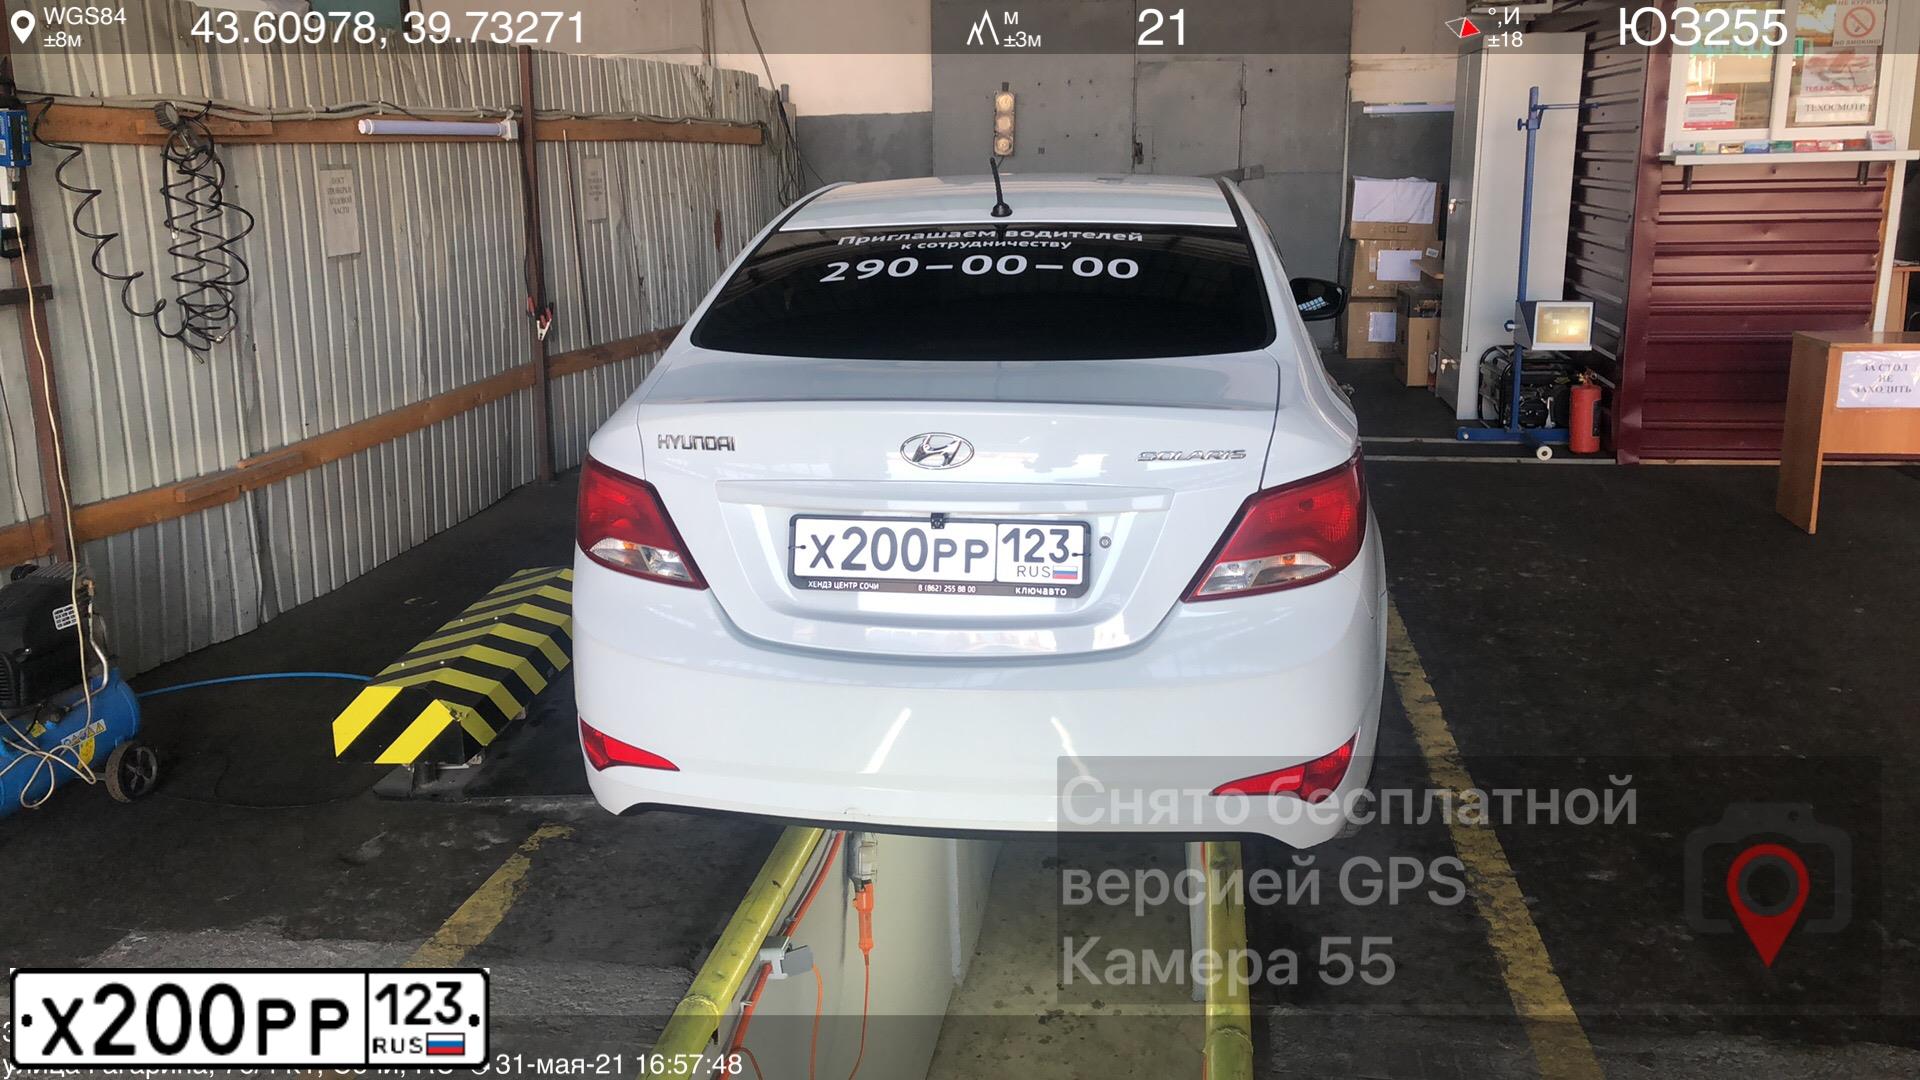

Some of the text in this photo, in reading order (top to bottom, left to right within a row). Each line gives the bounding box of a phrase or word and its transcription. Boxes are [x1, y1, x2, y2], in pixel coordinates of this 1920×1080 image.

[1805, 103, 1866, 113] ТЕХОСМОТР
[837, 230, 1143, 246] Приглашаем водителей
[917, 240, 1072, 250] сотрудничеству
[657, 434, 736, 452] HYUNDAI
[1137, 449, 1247, 462] SOLARIS
[808, 525, 1070, 574] Х200РР 123
[1015, 564, 1051, 578] RUS
[807, 580, 880, 591] ХЕНДЭ ЦЕНТР СОЧИ
